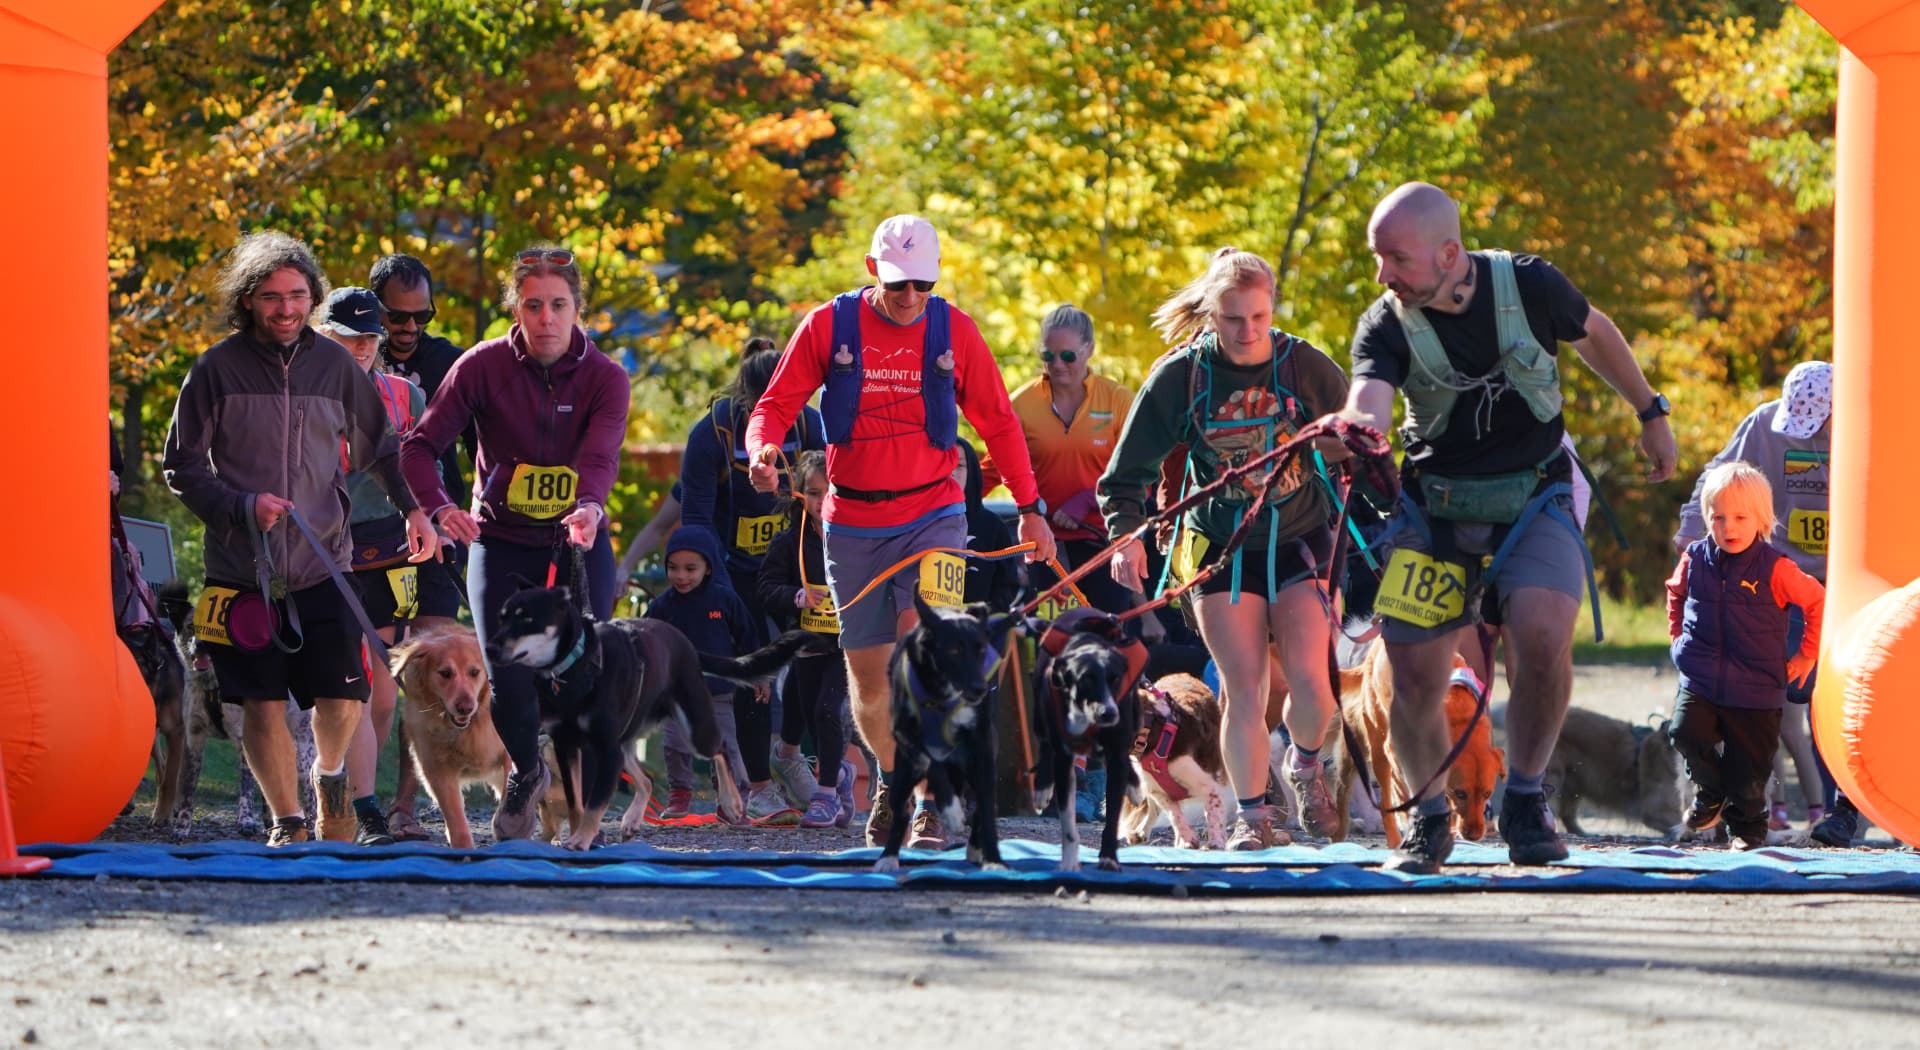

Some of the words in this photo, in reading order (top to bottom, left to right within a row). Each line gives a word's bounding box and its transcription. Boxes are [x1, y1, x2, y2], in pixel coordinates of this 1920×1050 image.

[524, 473, 572, 501] 180
[1799, 517, 1829, 542] 18
[933, 560, 964, 596] 198
[1402, 562, 1451, 610] 182
